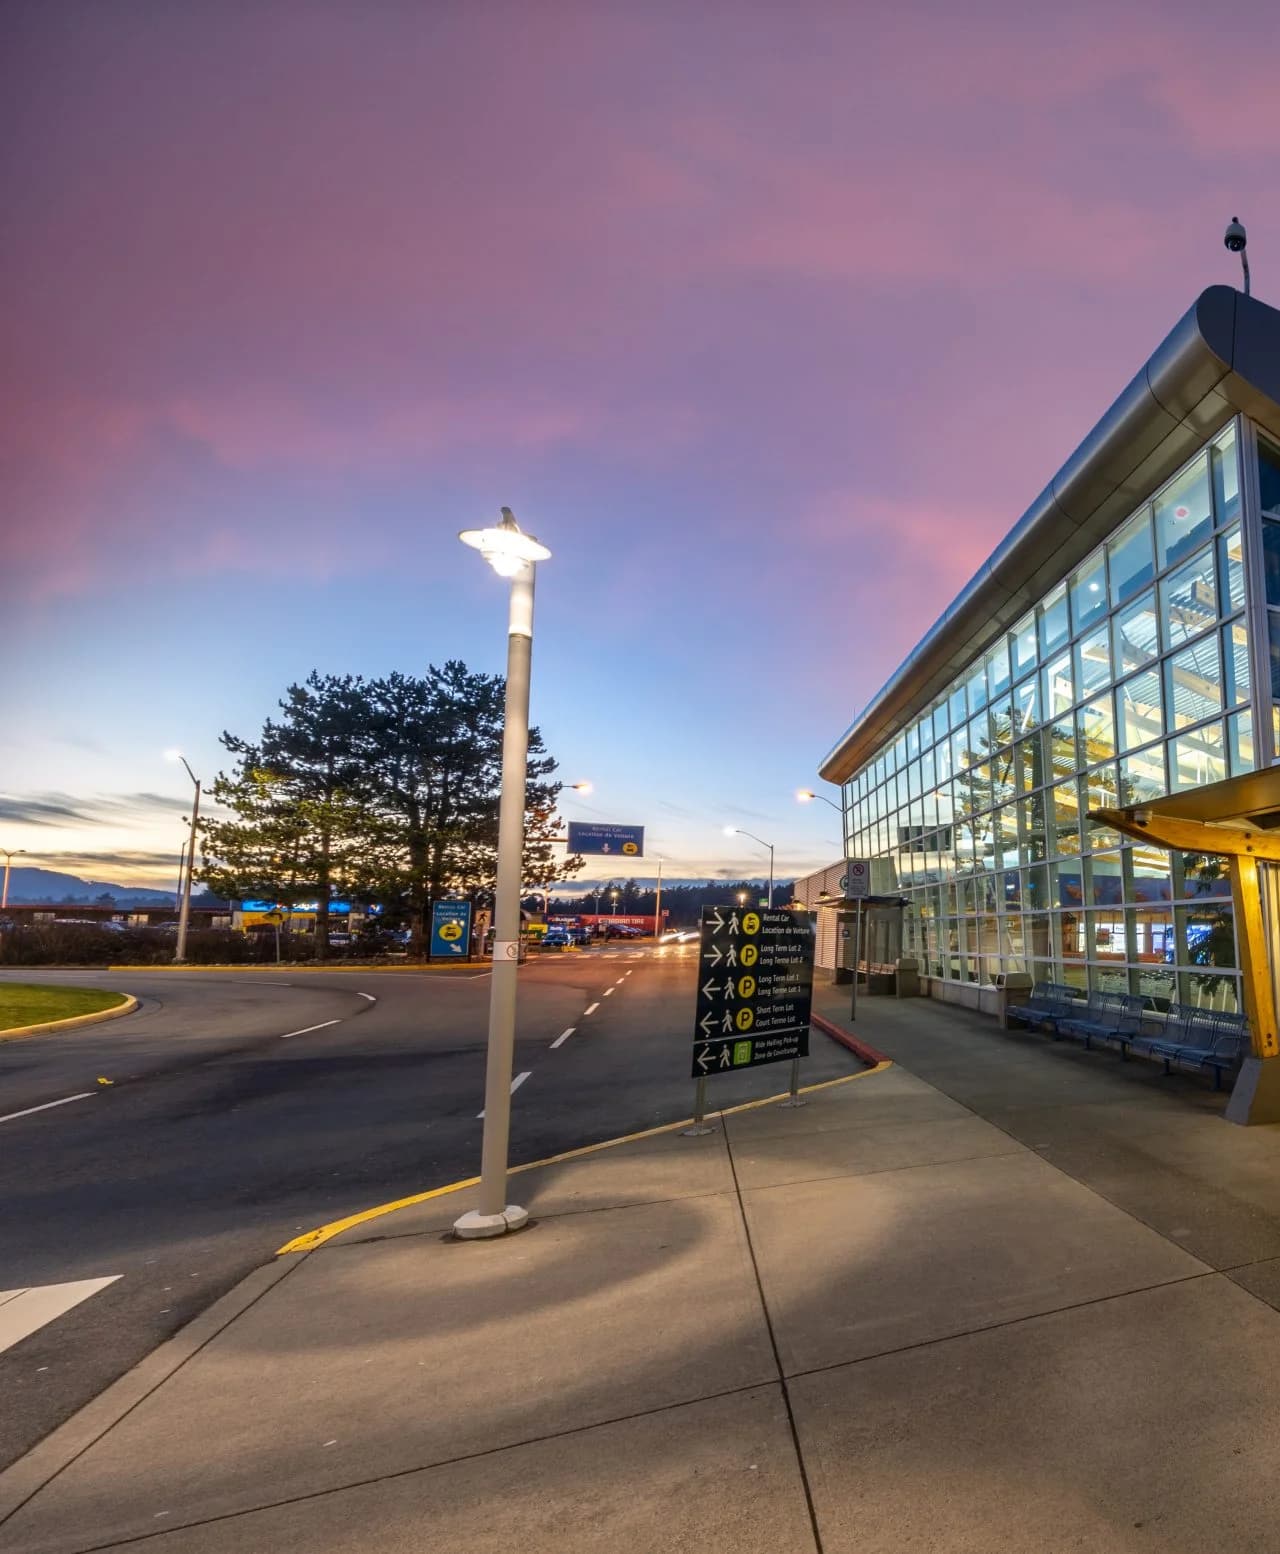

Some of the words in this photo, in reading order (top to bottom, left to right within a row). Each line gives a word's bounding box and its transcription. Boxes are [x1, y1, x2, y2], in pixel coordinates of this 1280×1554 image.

[763, 913, 780, 921] Rental
[781, 914, 790, 922] Car
[762, 926, 785, 934] Location
[760, 944, 774, 954] Long
[775, 944, 788, 952] Term
[788, 944, 798, 952] Lot
[798, 944, 802, 952] 2
[760, 956, 773, 966] Long
[774, 956, 790, 964] Terme
[790, 956, 799, 964] Lot
[799, 956, 804, 964] 2
[758, 975, 772, 985] Long
[773, 974, 786, 982] Term
[786, 974, 796, 982] Lot
[757, 987, 771, 997] Long
[772, 986, 788, 994] Terme
[788, 985, 798, 993] Lot
[756, 1005, 771, 1014] Short
[772, 1004, 785, 1013] Term
[785, 1003, 795, 1011] Lot
[755, 1018, 770, 1027] Court
[771, 1017, 787, 1025] Terme
[787, 1015, 796, 1024] Lot
[755, 1040, 766, 1049] Ride
[754, 1052, 766, 1060] Zone
[767, 1050, 773, 1058] de
